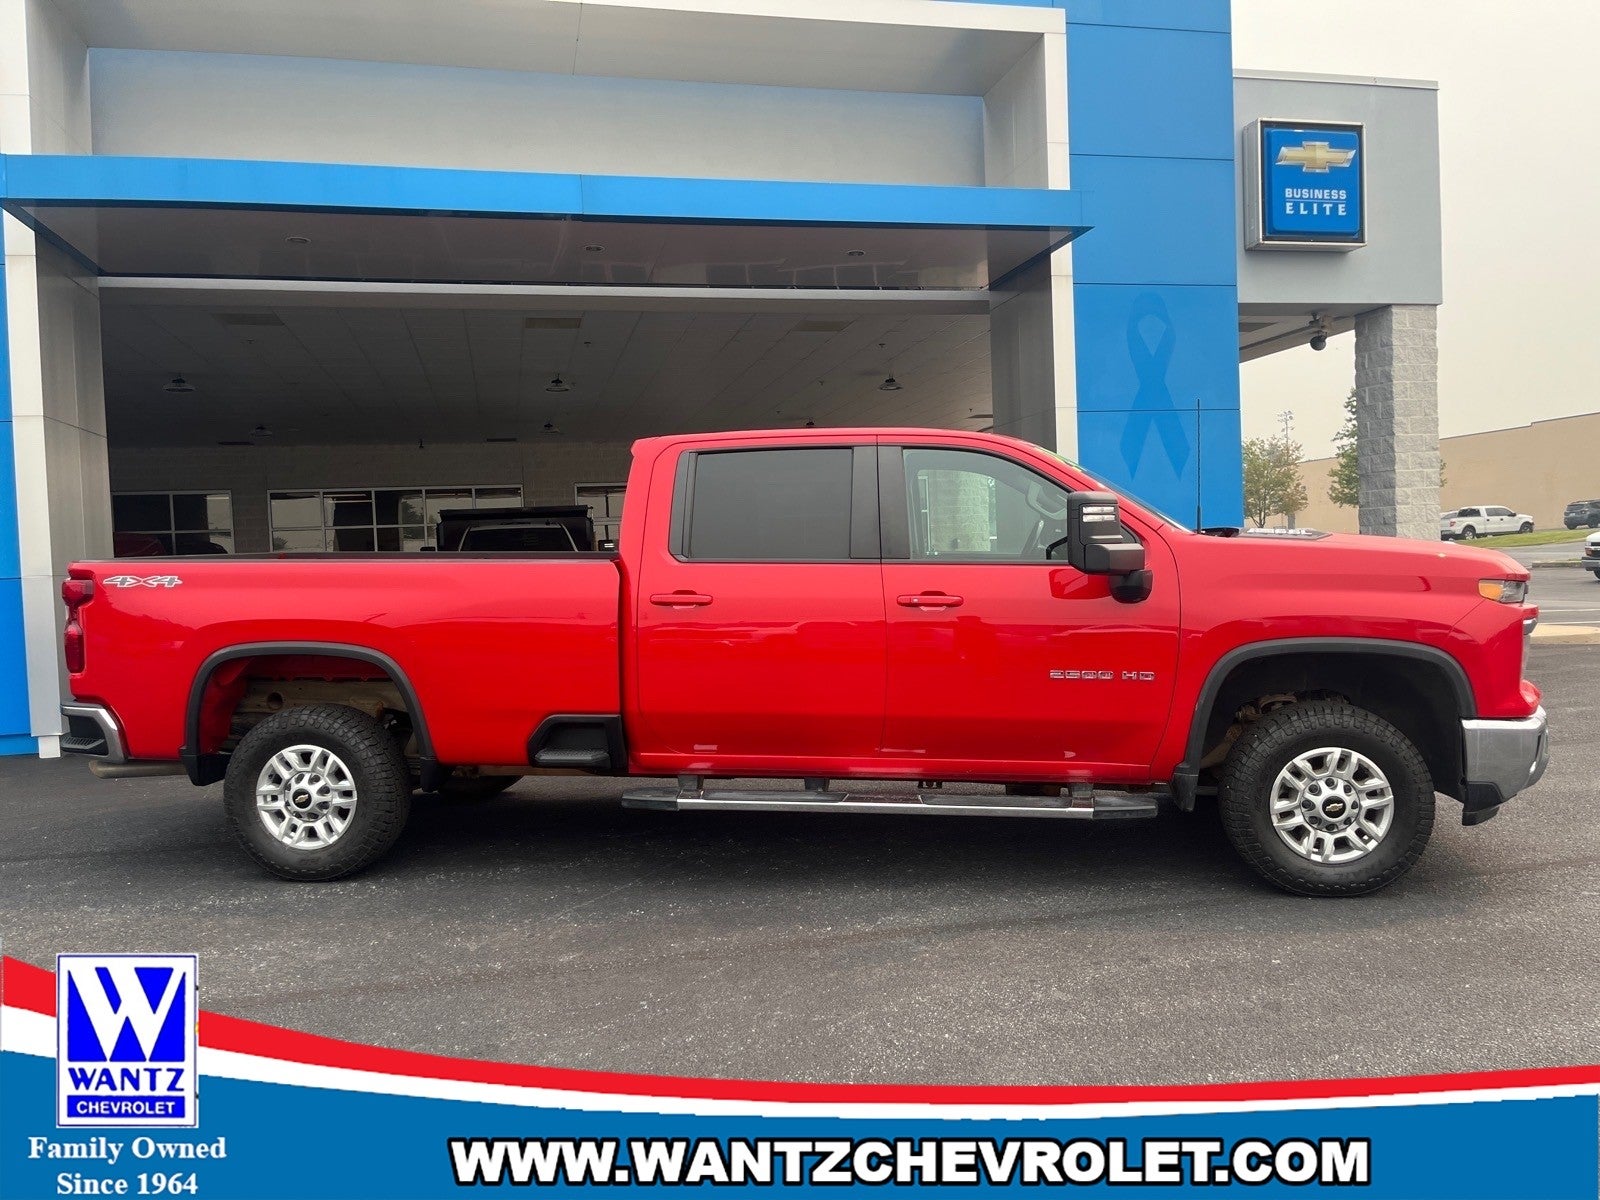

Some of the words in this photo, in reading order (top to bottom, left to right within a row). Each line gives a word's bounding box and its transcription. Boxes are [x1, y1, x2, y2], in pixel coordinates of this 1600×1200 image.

[1285, 188, 1347, 199] BUSINESS
[1285, 202, 1347, 216] ELITE
[1049, 670, 1113, 679] 2500
[1122, 671, 1155, 680] HD
